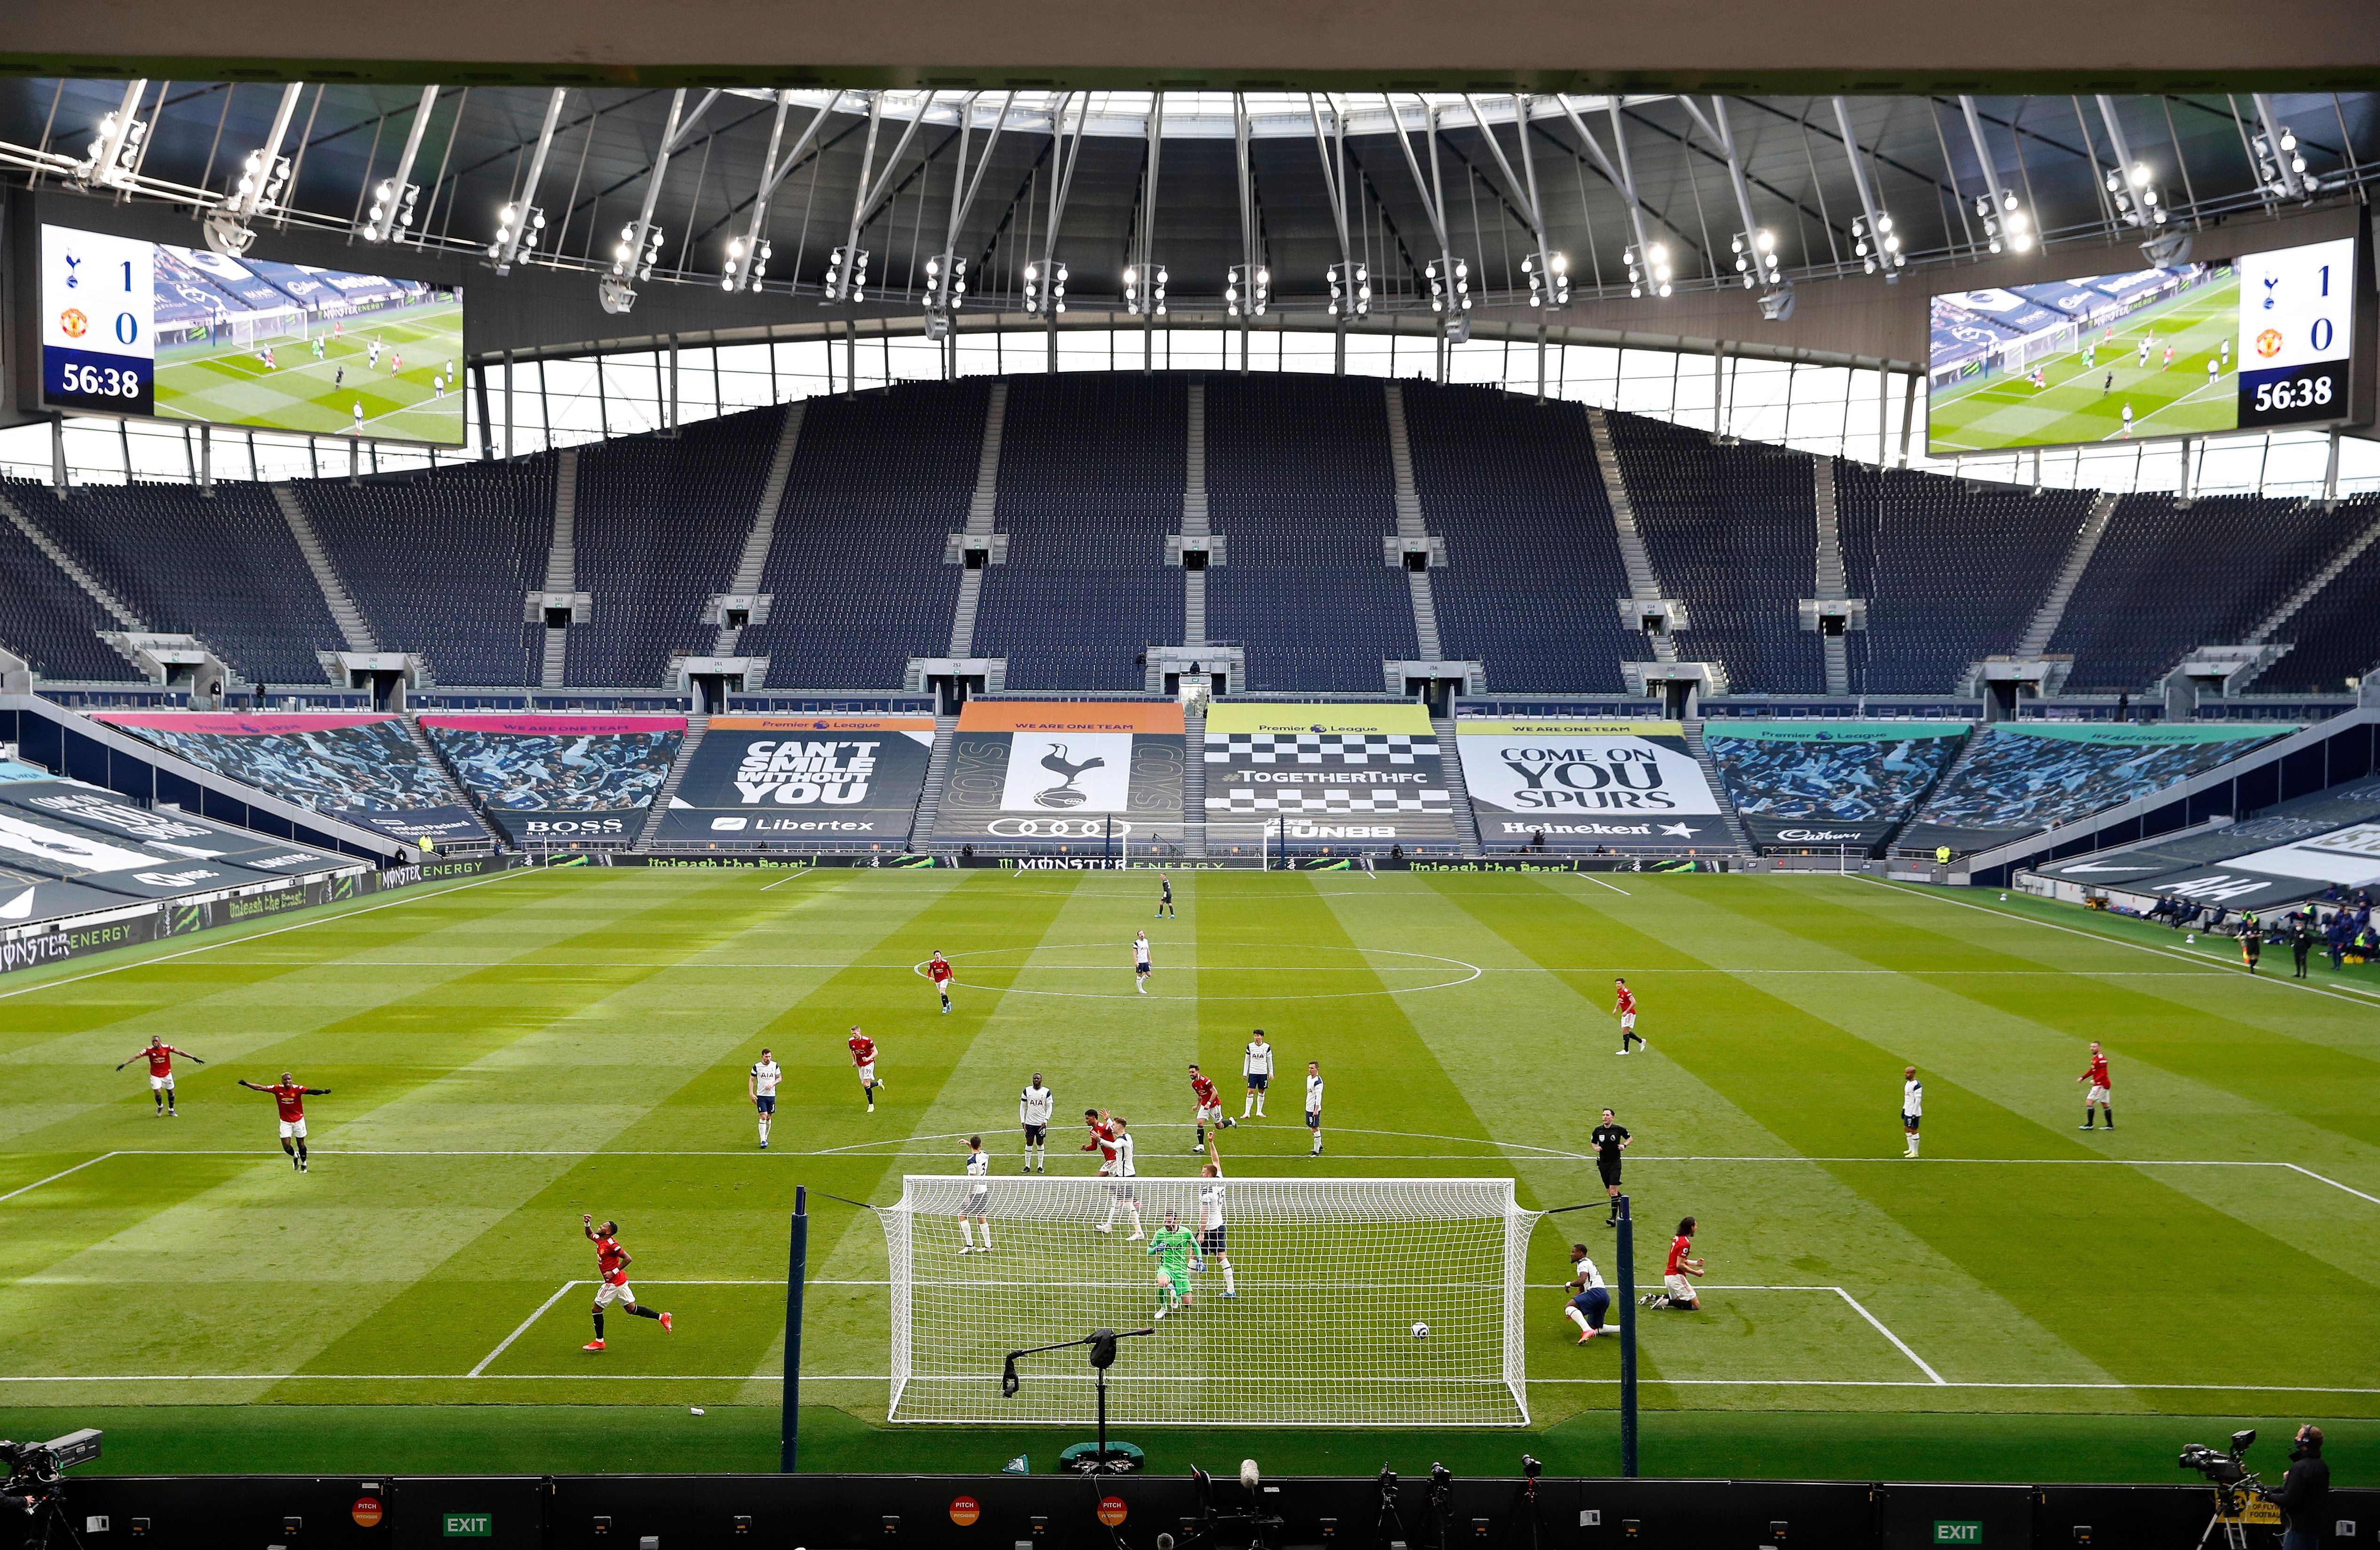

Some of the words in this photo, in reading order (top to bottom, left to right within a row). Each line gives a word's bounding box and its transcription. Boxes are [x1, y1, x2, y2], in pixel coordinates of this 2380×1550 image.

[120, 261, 131, 292] 1
[2318, 265, 2329, 297] 1
[358, 302, 385, 313] ENERGY
[116, 313, 137, 344] 0
[2310, 318, 2333, 351] 0
[63, 363, 139, 399] 56:38
[2255, 376, 2333, 412] 56:38
[747, 741, 881, 757] CAN'T
[1500, 748, 1598, 762] COME
[1606, 748, 1657, 762] ON
[738, 756, 877, 773] SMILE
[737, 771, 872, 783] WITHOUT
[948, 742, 1012, 808] COYS
[1128, 743, 1185, 810] COYS
[1504, 761, 1663, 790] YOU
[733, 781, 869, 804] YOU
[1513, 790, 1676, 809] SPURS
[59, 804, 169, 828] YOU
[424, 820, 471, 830] Packard
[526, 818, 623, 832] BOSS
[754, 819, 875, 831] Libertex
[1266, 826, 1396, 838] FUN88
[1500, 822, 1651, 835] Heineken
[1776, 829, 1862, 841] Cadbury
[1018, 857, 1126, 869] MONSTER
[381, 864, 422, 889] MONSTER
[423, 861, 483, 877] ENERGY
[2151, 875, 2273, 901] AIA
[229, 896, 263, 918] Unleash
[264, 894, 280, 911] the
[71, 924, 131, 949] ENERGY
[1264, 1080, 1268, 1088] 7
[981, 1162, 986, 1176] 3
[447, 1518, 487, 1532] EXIT
[1938, 1525, 1978, 1539] EXIT
